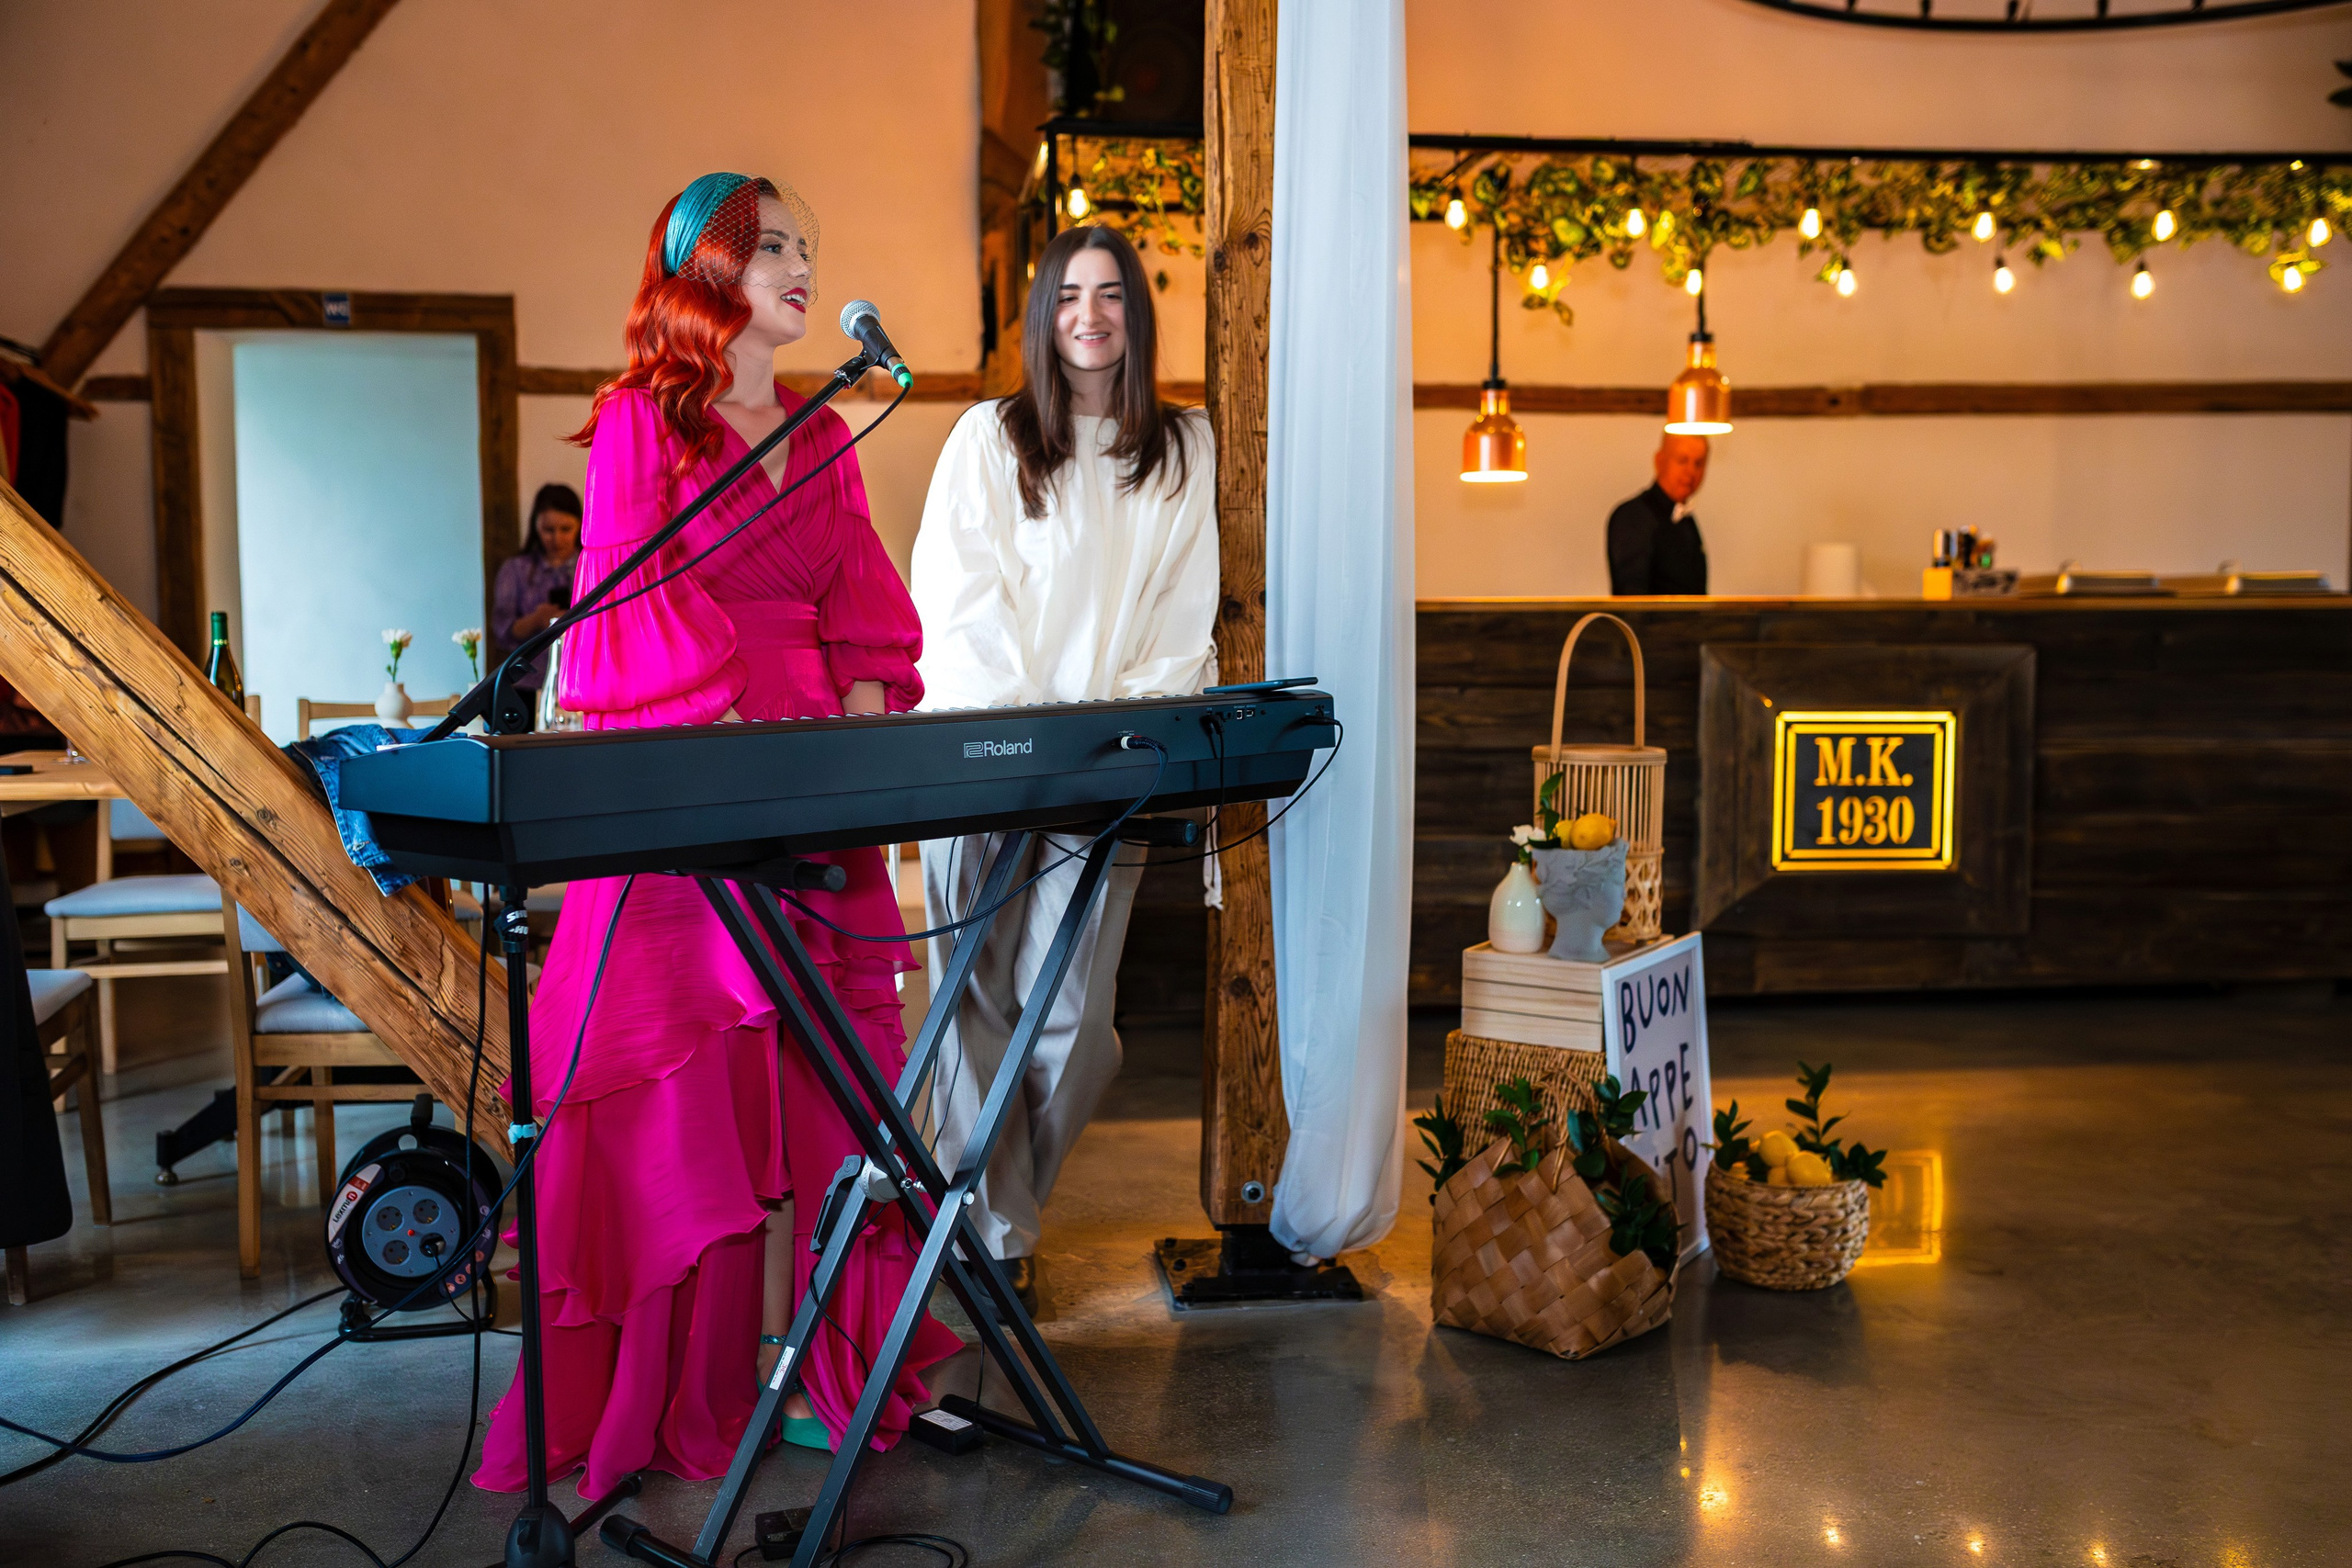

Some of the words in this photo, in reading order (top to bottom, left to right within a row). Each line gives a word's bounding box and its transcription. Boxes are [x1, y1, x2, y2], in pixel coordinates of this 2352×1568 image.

[982, 738, 1033, 757] Roland
[1814, 737, 1914, 786] M.K.
[1815, 795, 1916, 845] 1930
[1621, 964, 1690, 1055] BUON
[1631, 1043, 1693, 1130] APPE
